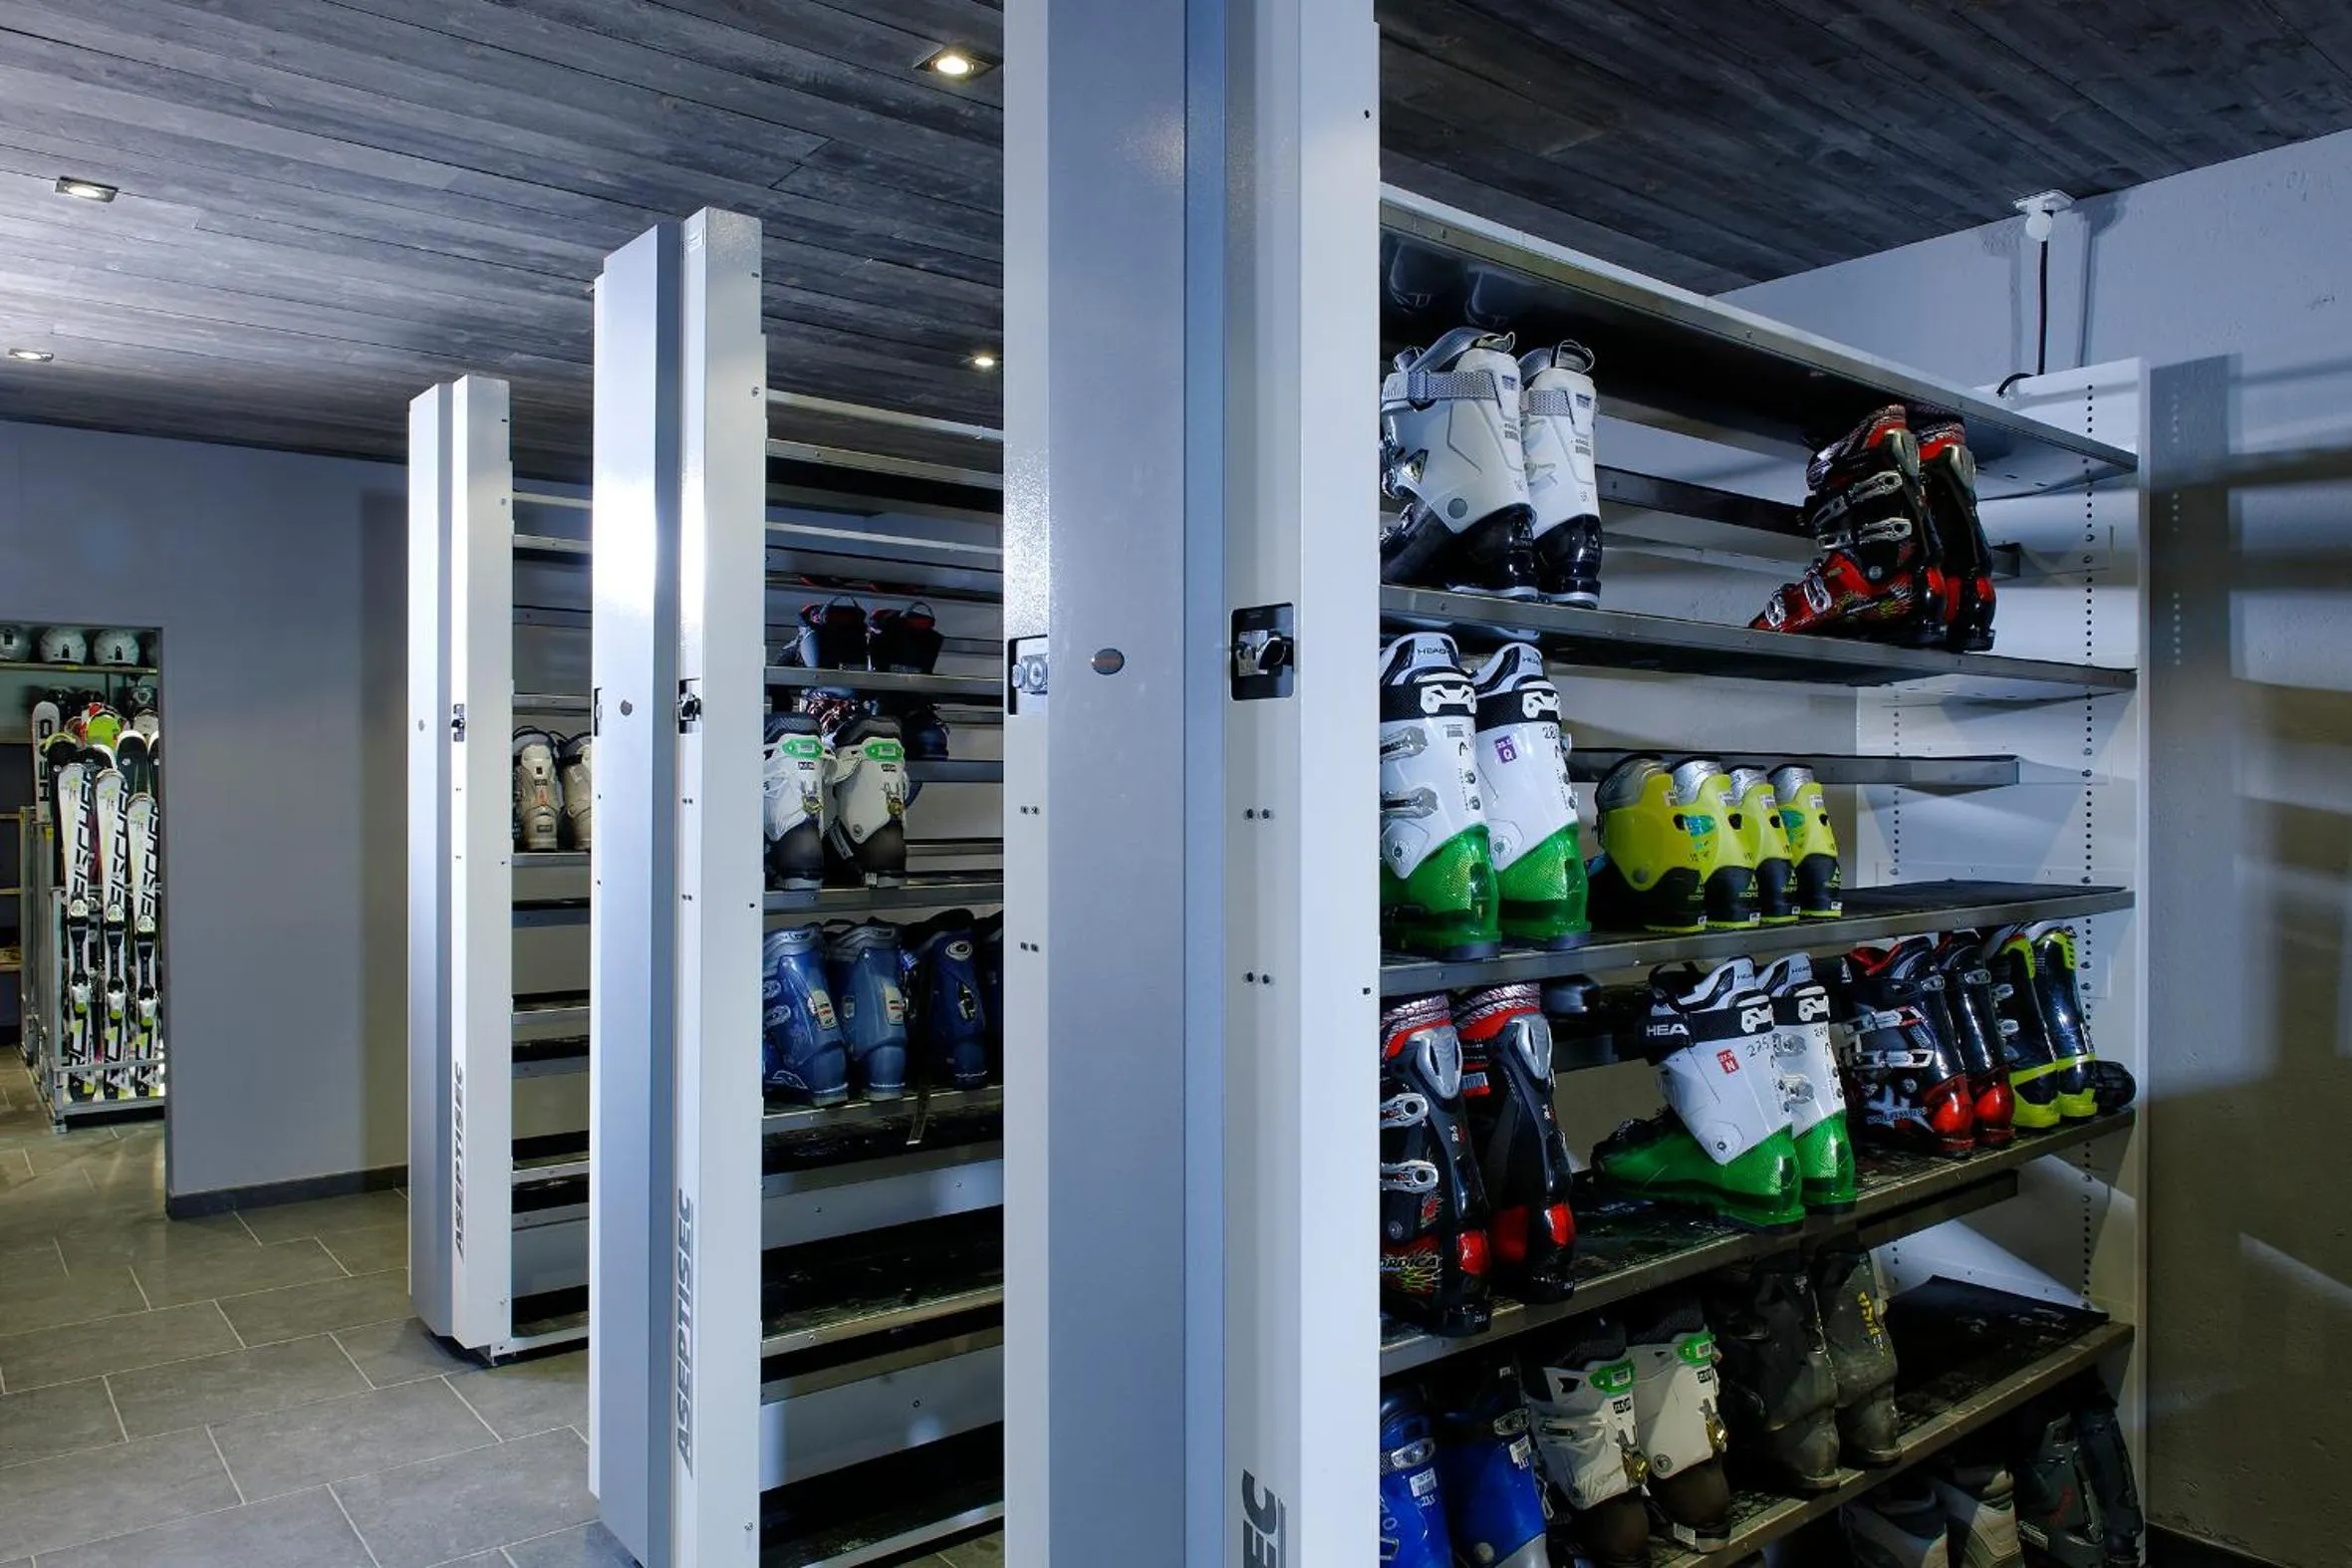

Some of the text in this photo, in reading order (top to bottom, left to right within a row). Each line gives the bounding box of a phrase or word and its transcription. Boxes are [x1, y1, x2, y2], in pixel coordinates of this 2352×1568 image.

[1647, 1023, 1690, 1037] HEA
[1381, 1256, 1439, 1268] ORDICA
[677, 1188, 693, 1479] ASEPTISEC
